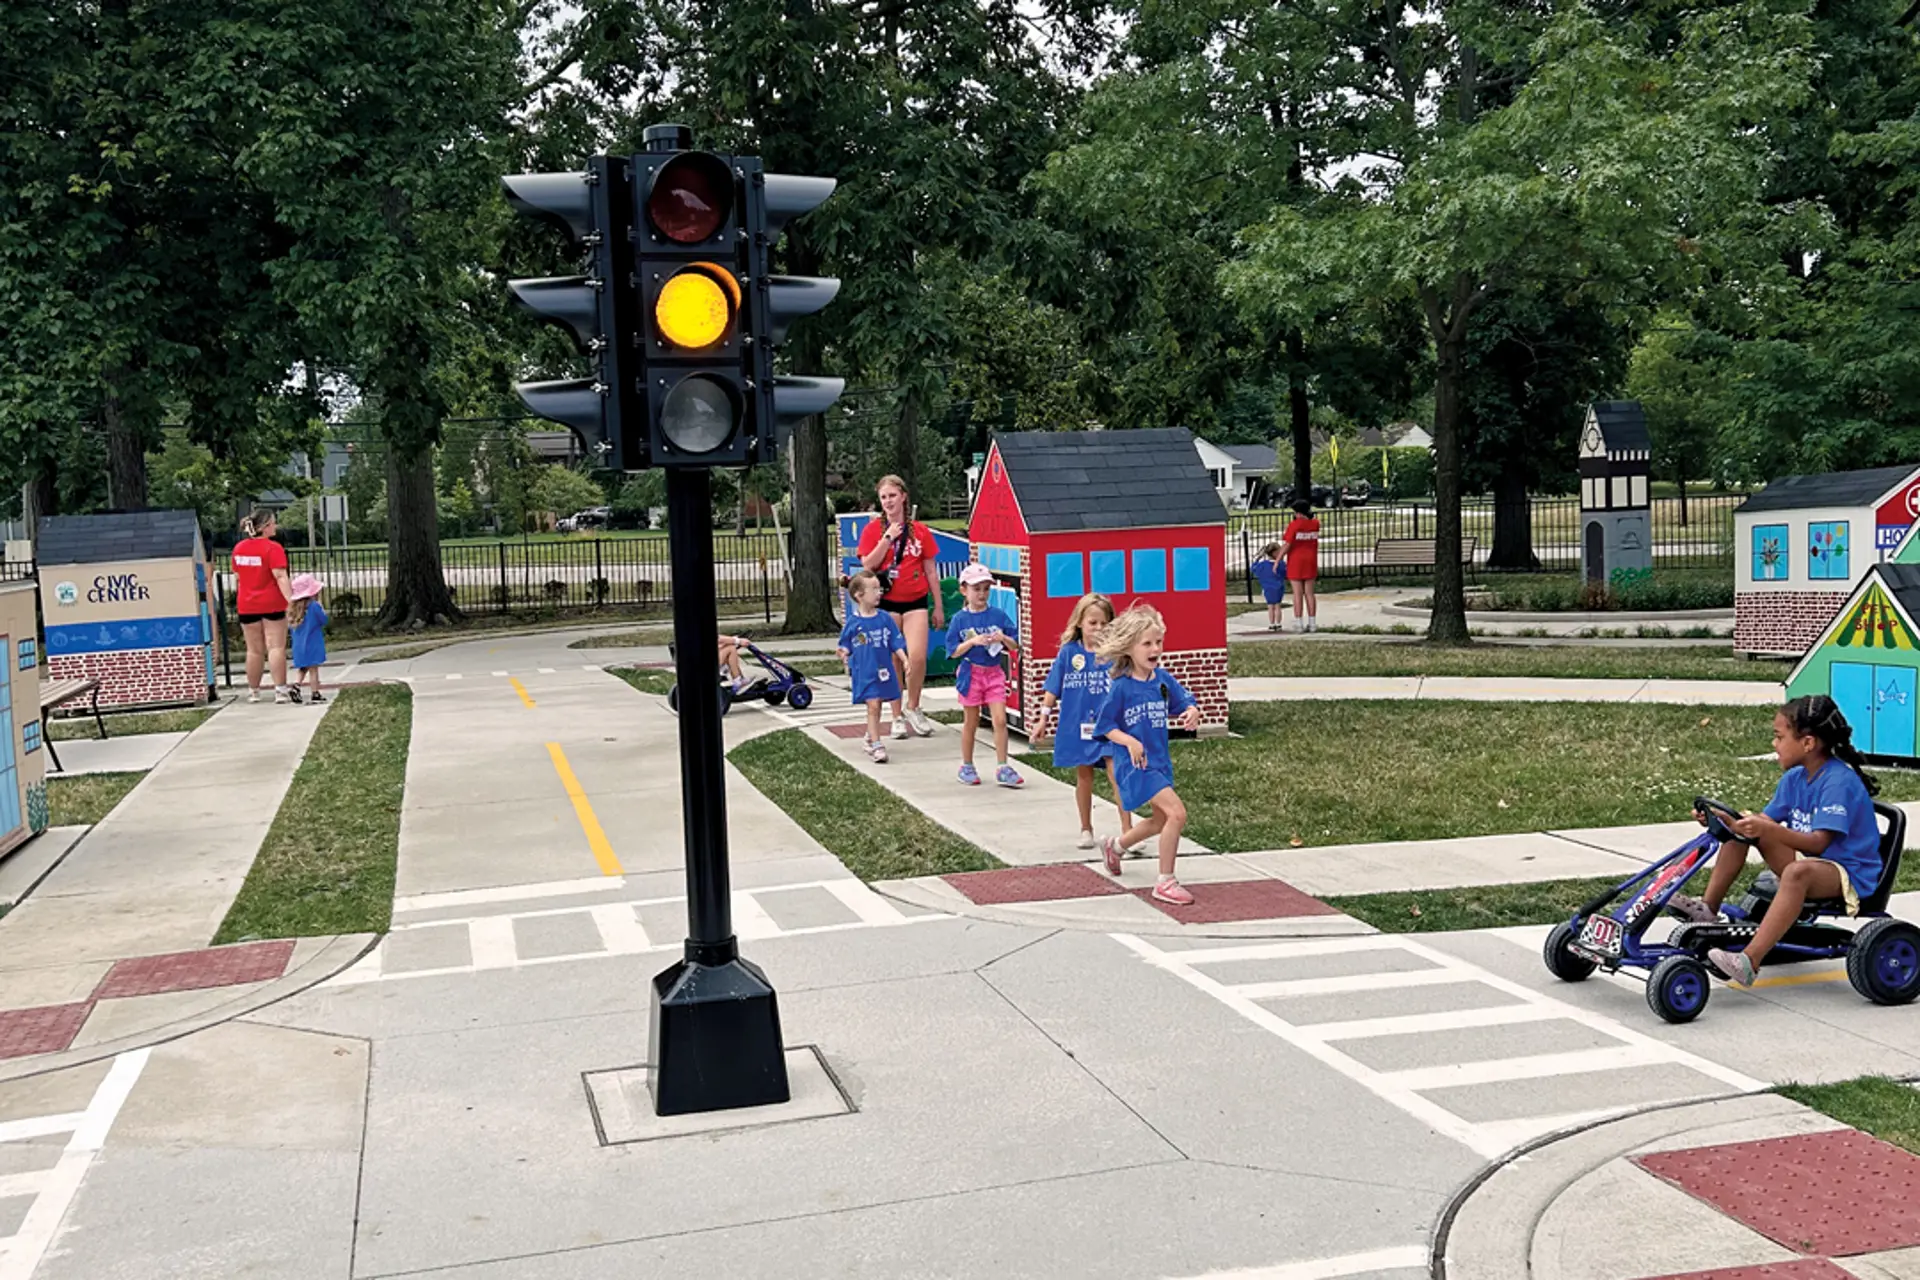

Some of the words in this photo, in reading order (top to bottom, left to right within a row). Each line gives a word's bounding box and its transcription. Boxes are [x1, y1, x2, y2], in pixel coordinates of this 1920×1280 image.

[93, 573, 138, 589] CIVIC
[86, 585, 150, 603] CENTER
[1861, 603, 1890, 615] PET
[1854, 618, 1898, 632] SHOP
[1594, 920, 1612, 943] 01
